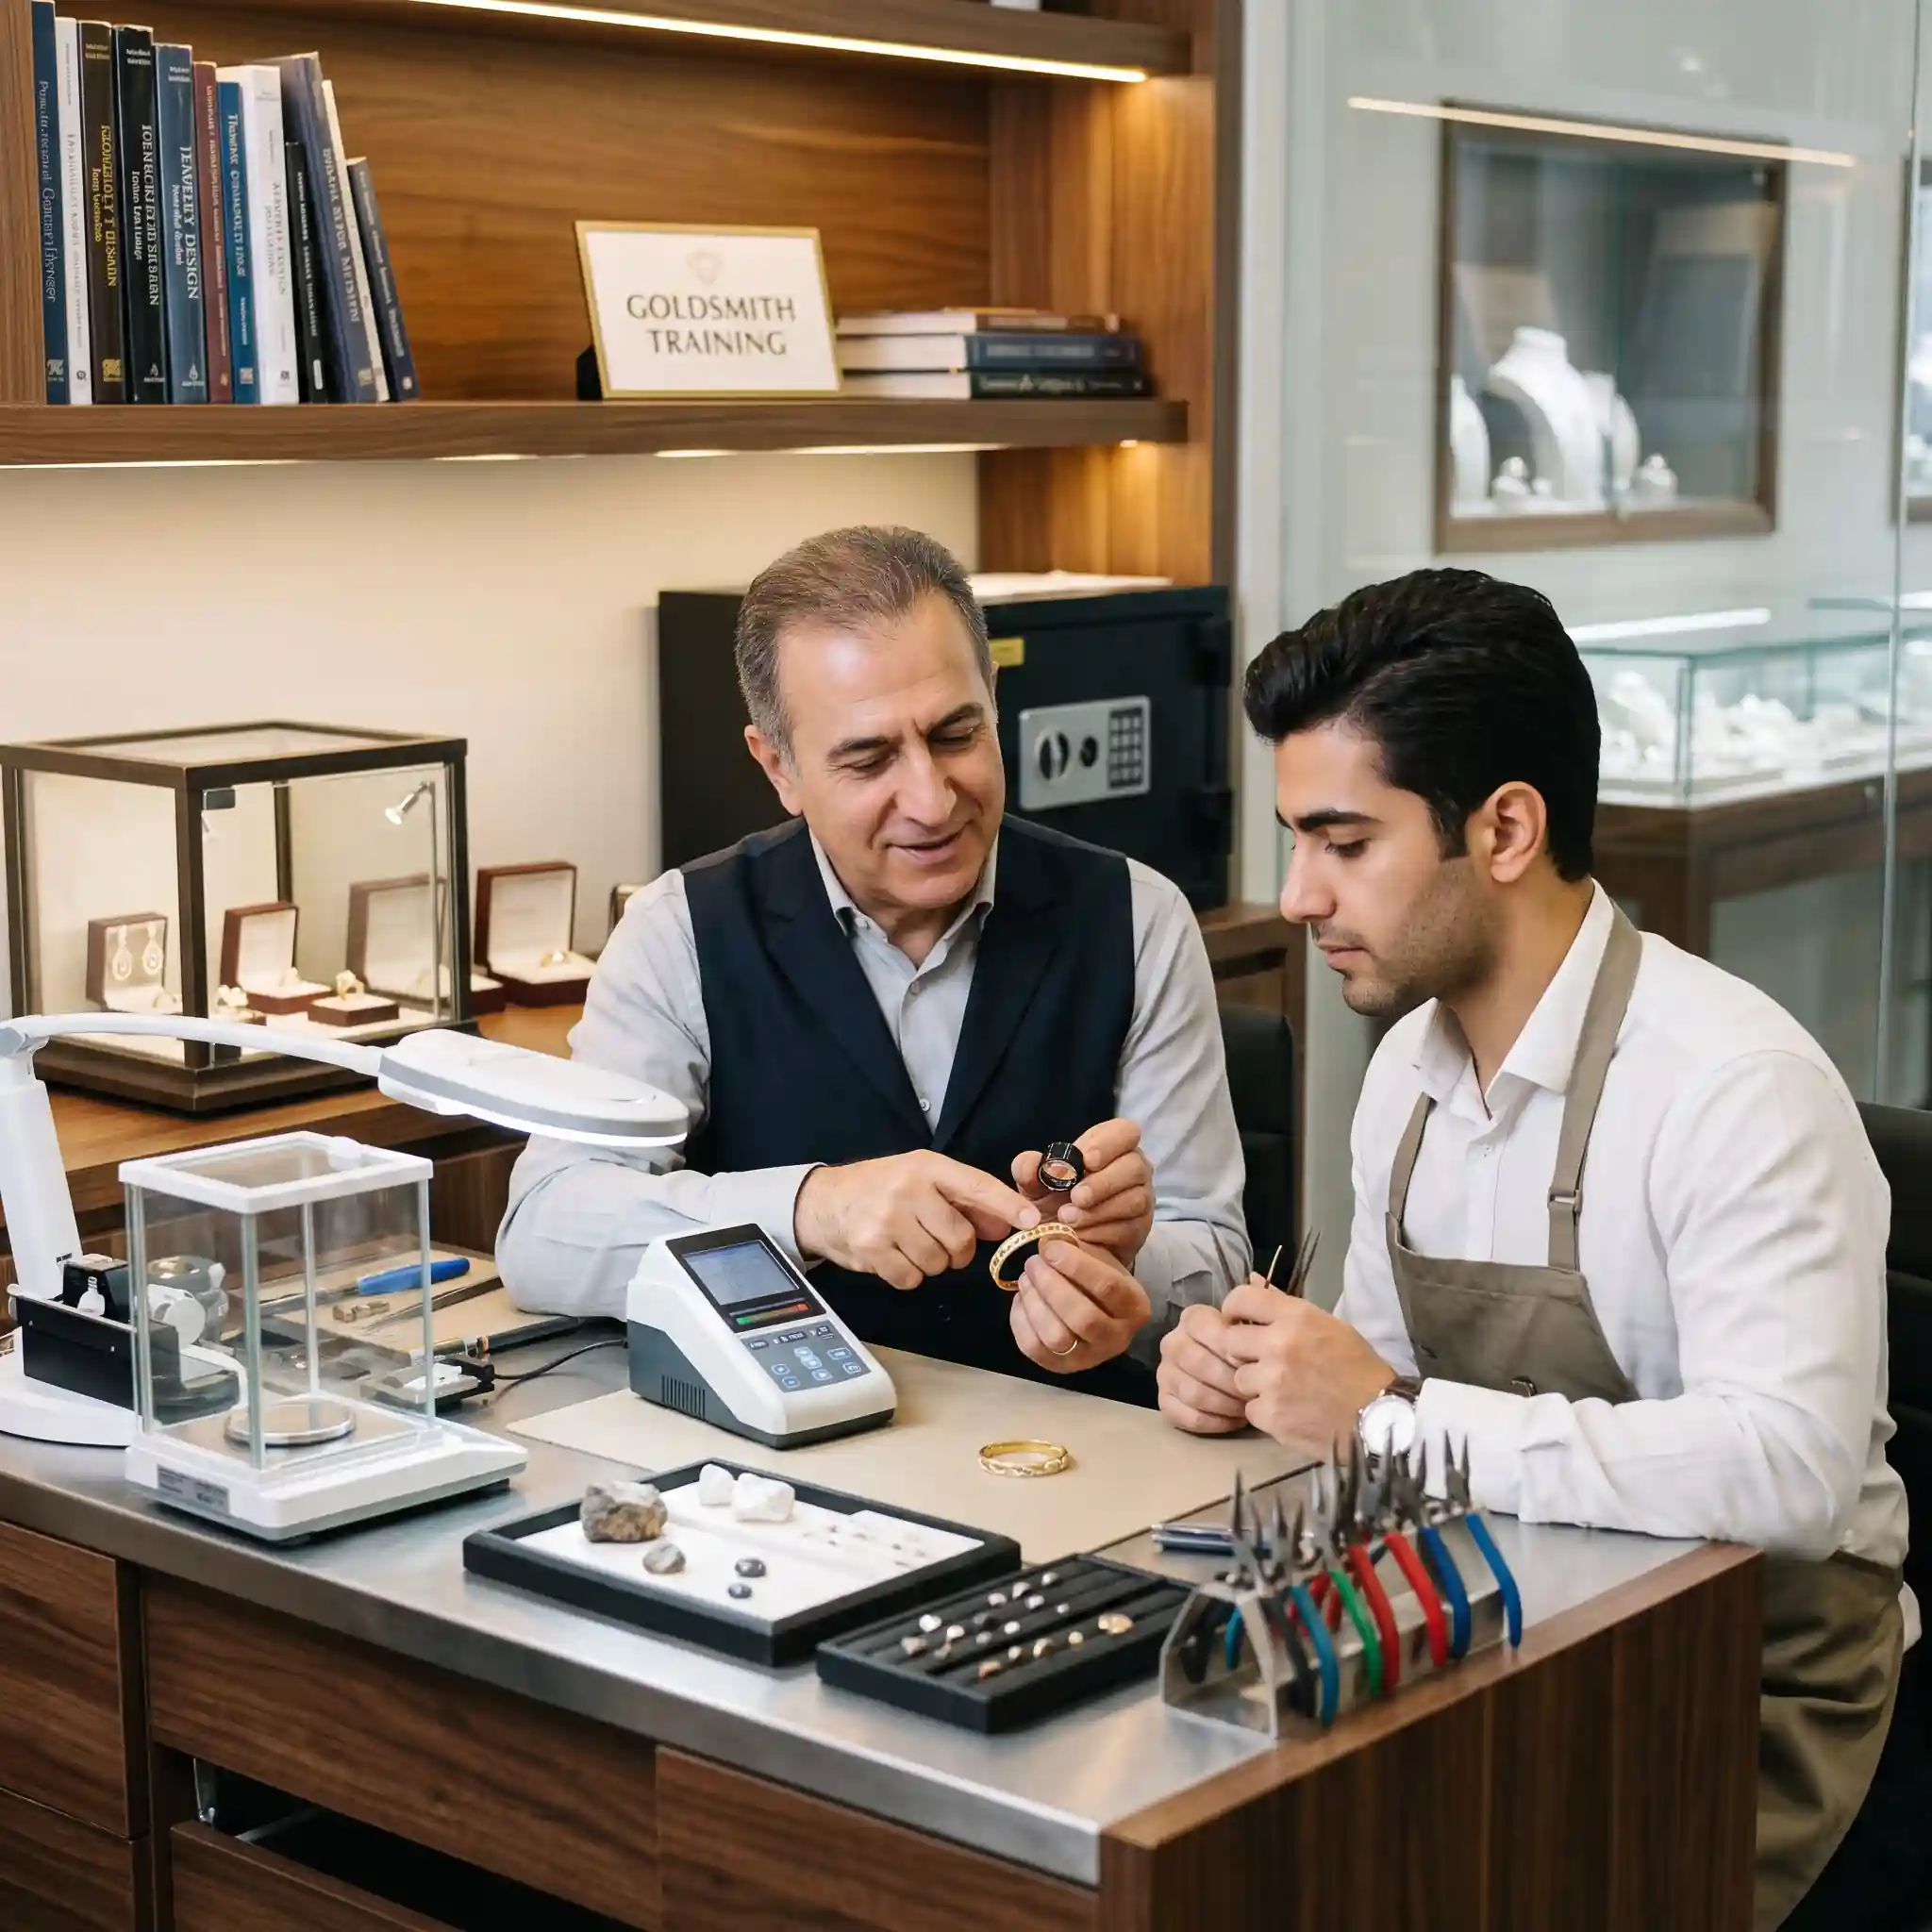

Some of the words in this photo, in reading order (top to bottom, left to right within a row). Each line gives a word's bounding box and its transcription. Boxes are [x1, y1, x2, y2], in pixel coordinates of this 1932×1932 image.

[185, 233, 200, 300] DESIGN
[626, 294, 797, 322] GOLDSMITH
[647, 328, 788, 356] TRAINING
